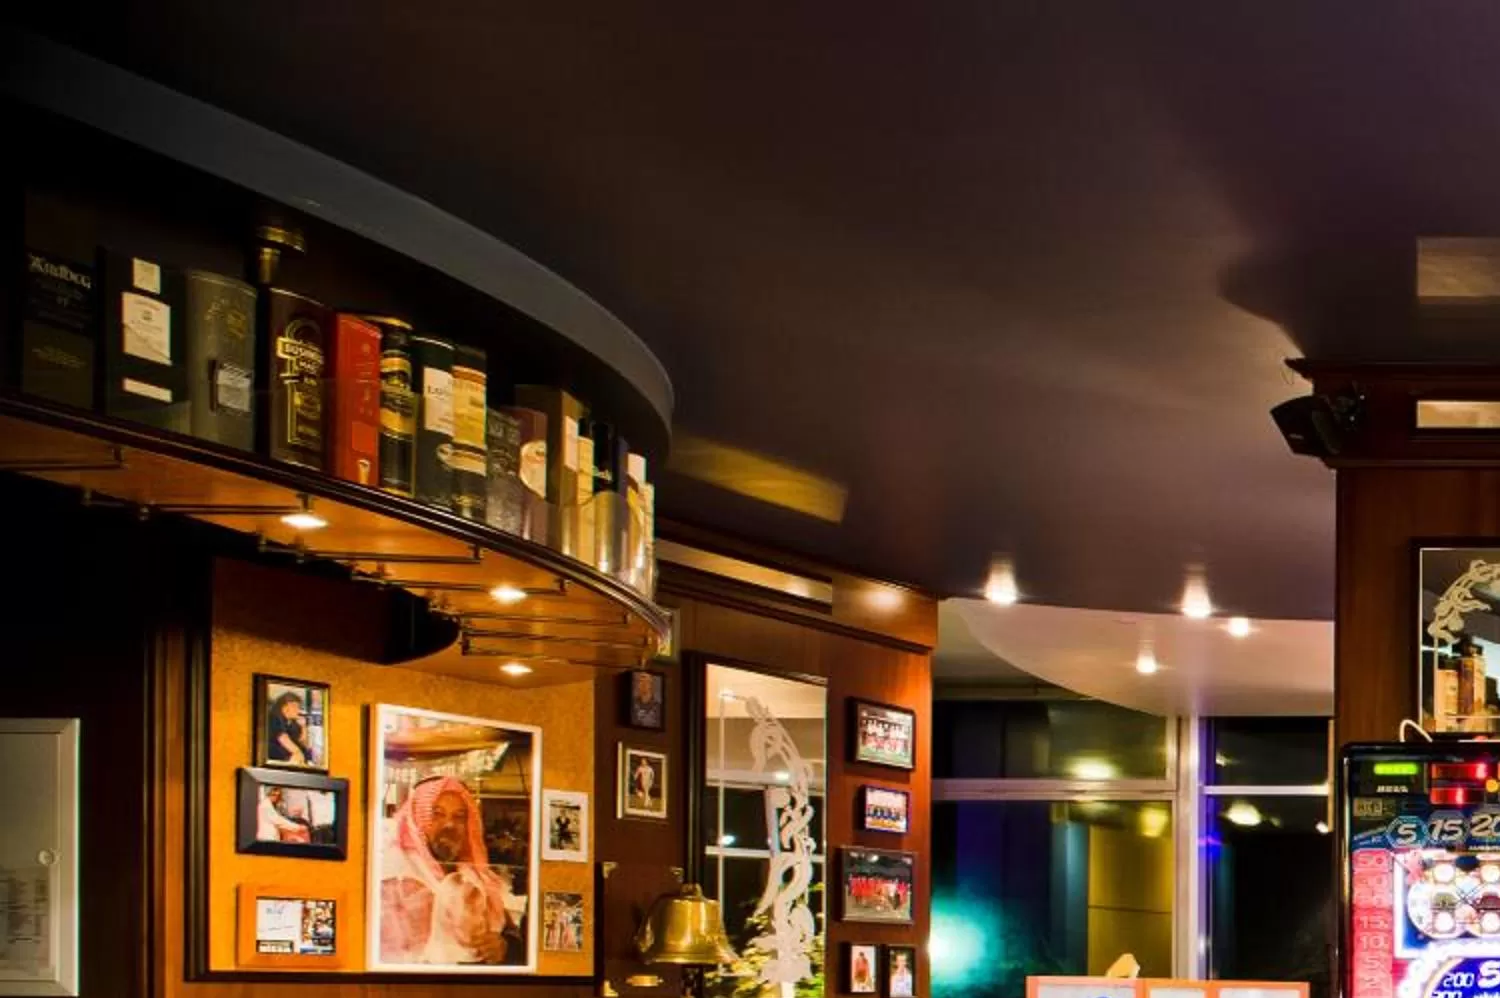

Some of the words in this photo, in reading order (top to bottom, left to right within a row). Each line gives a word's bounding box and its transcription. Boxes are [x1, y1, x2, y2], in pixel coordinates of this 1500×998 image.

[1397, 823, 1417, 844] 5
[1432, 818, 1464, 841] 15
[1443, 972, 1474, 987] 200
